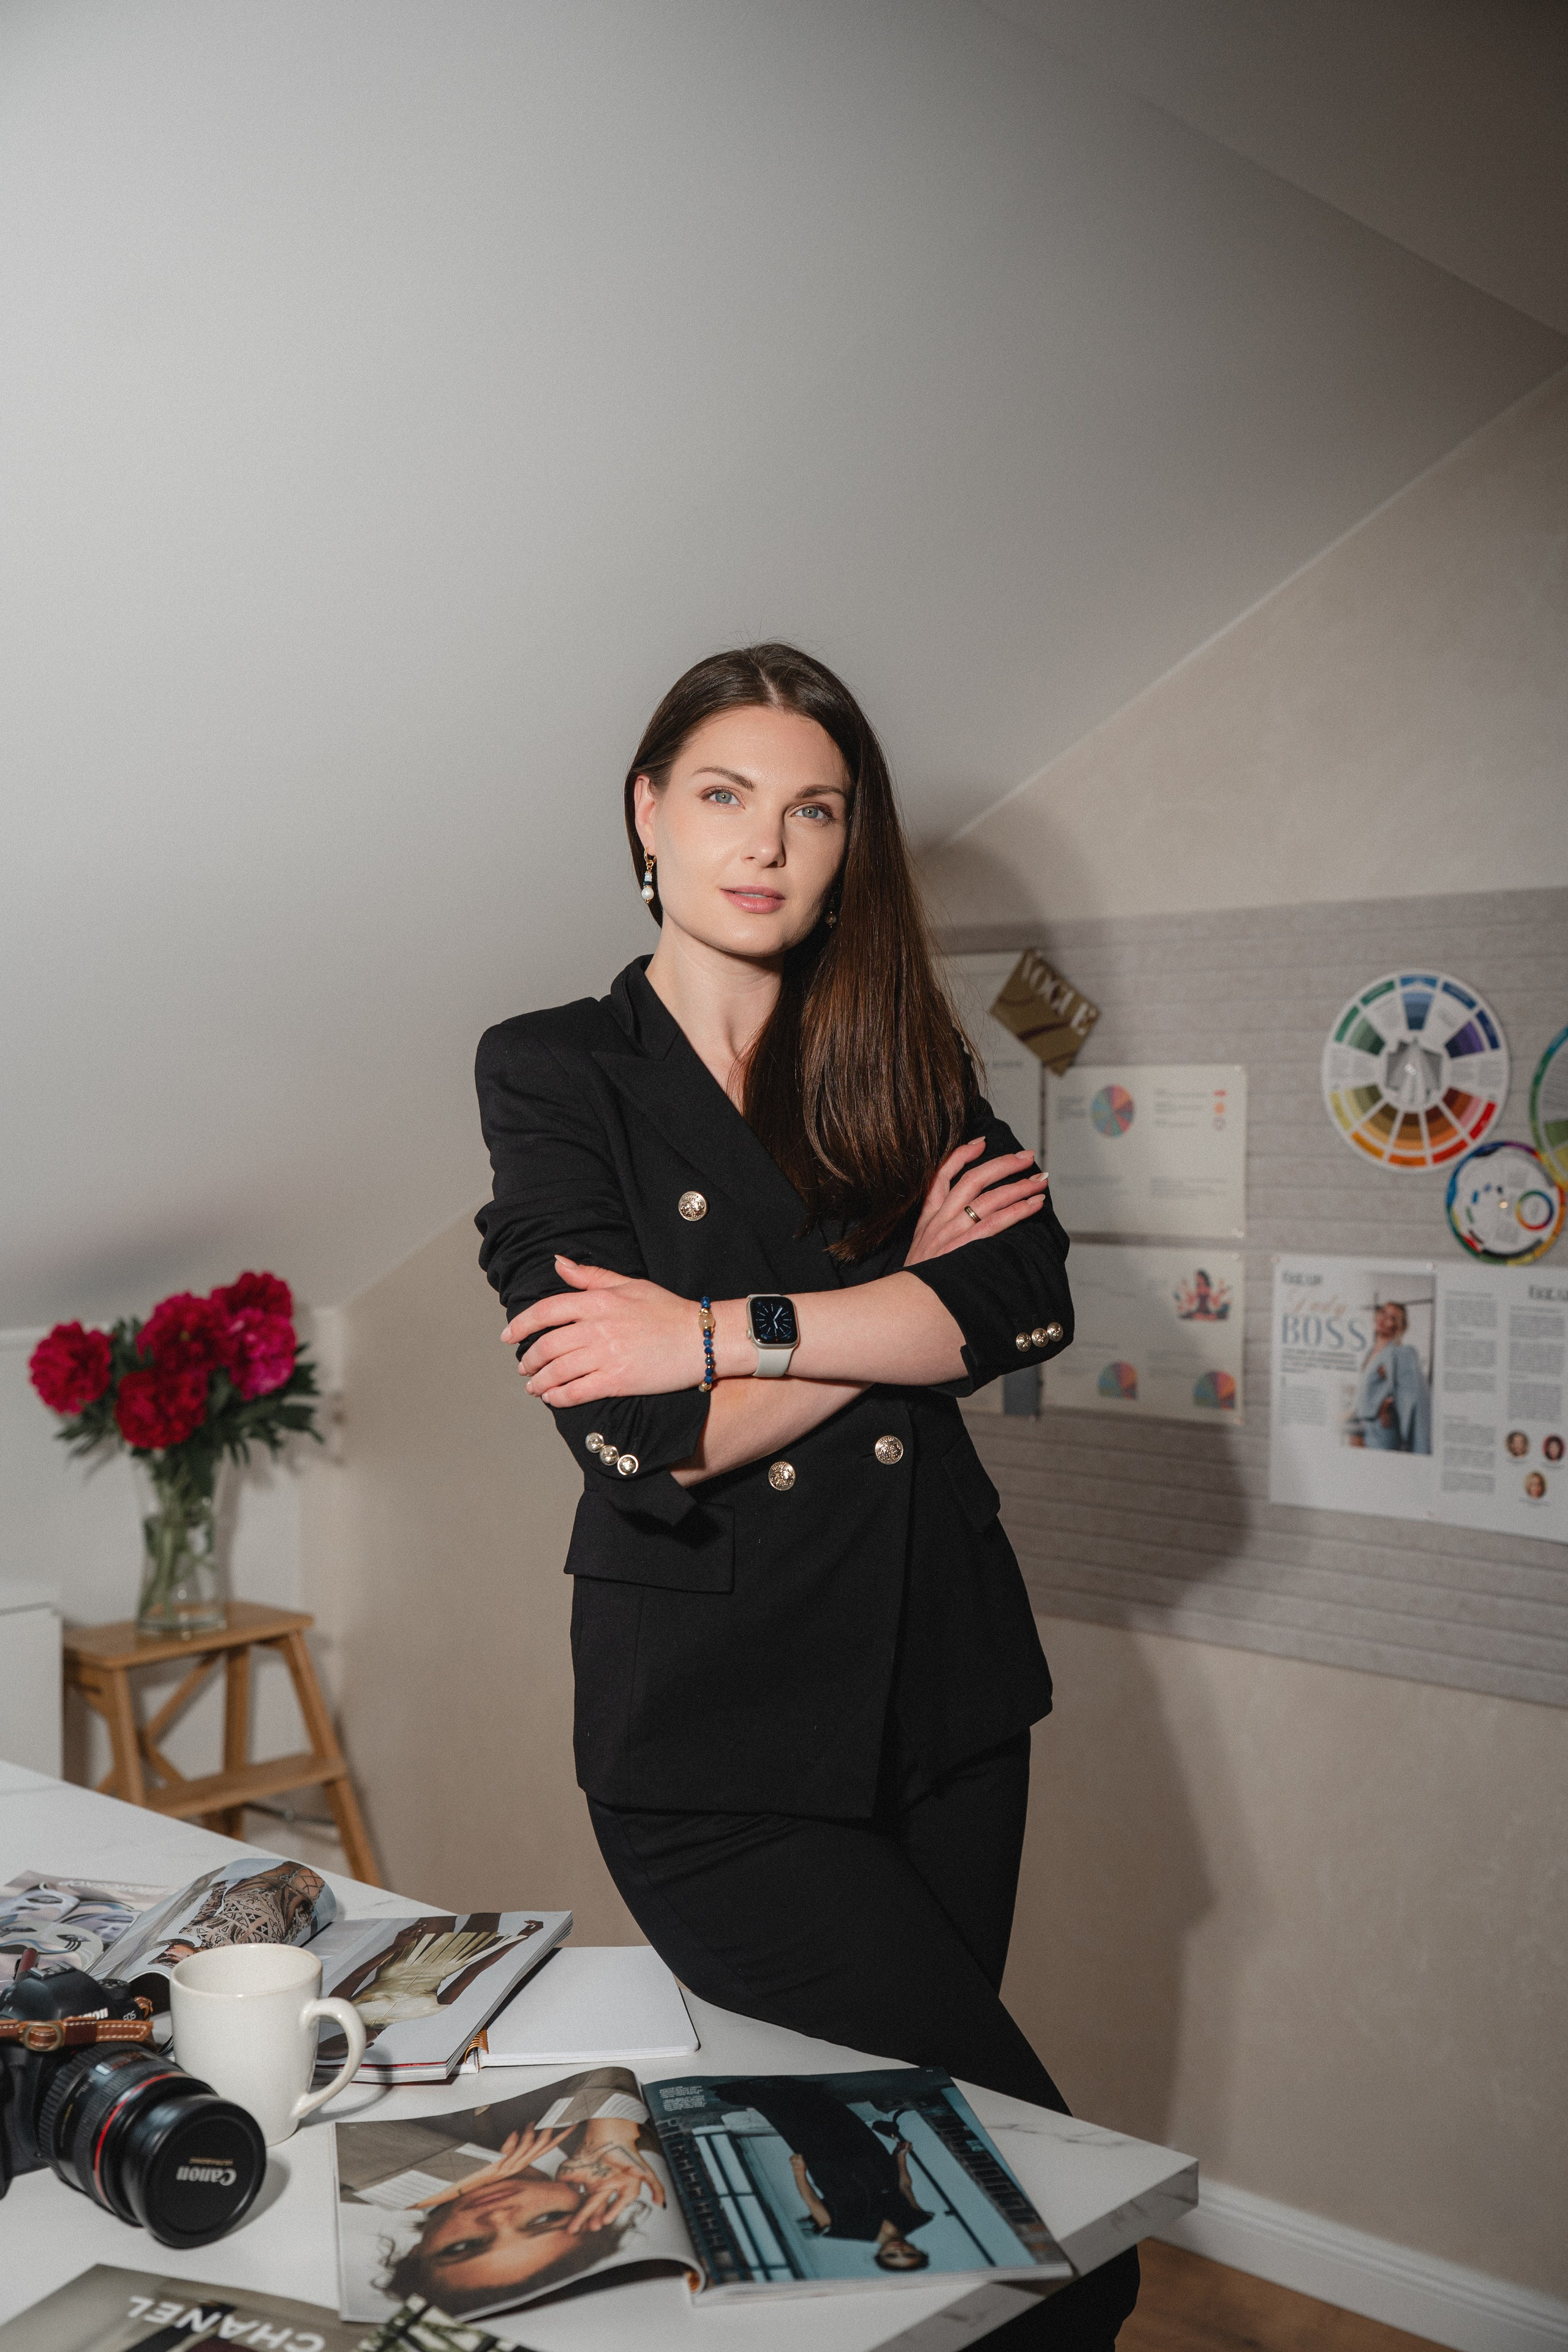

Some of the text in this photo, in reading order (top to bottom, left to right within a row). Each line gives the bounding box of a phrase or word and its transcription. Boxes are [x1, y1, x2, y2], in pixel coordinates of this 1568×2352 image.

[1282, 1313, 1367, 1352] BOSS
[176, 2166, 237, 2186] Canon
[127, 2296, 325, 2352] CHANEL
